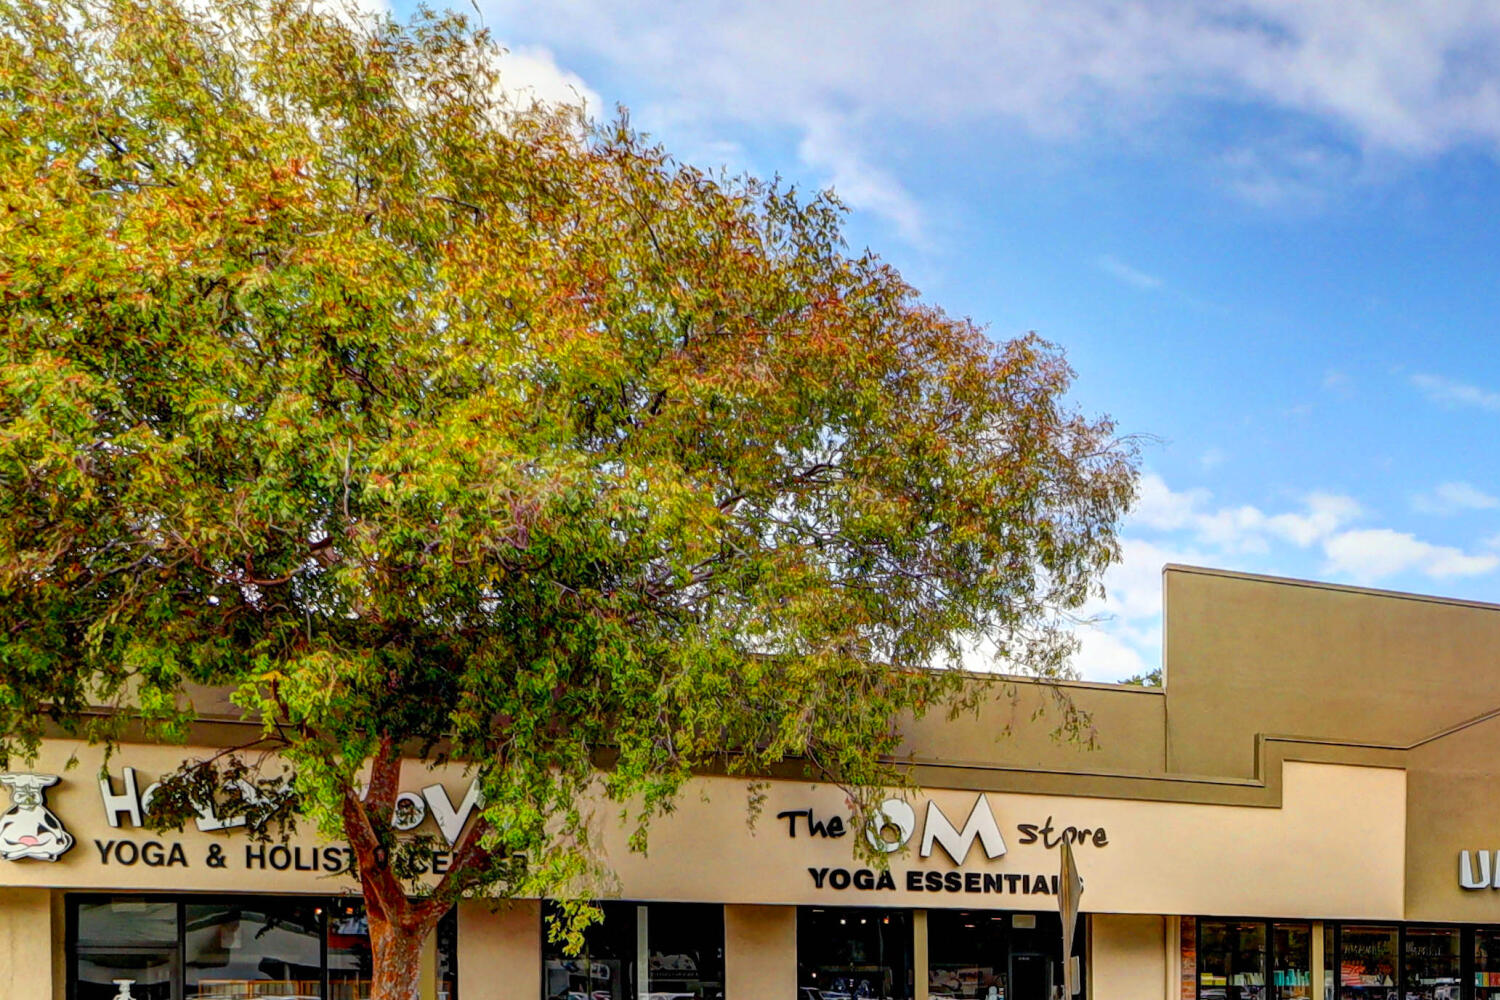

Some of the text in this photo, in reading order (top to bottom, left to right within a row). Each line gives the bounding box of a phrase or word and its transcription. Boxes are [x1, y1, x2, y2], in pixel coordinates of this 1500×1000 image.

[777, 793, 1109, 866] The OM store
[95, 840, 189, 868] YOGA
[205, 843, 227, 868] &
[808, 867, 1084, 896] YOGA ESSENTIA
